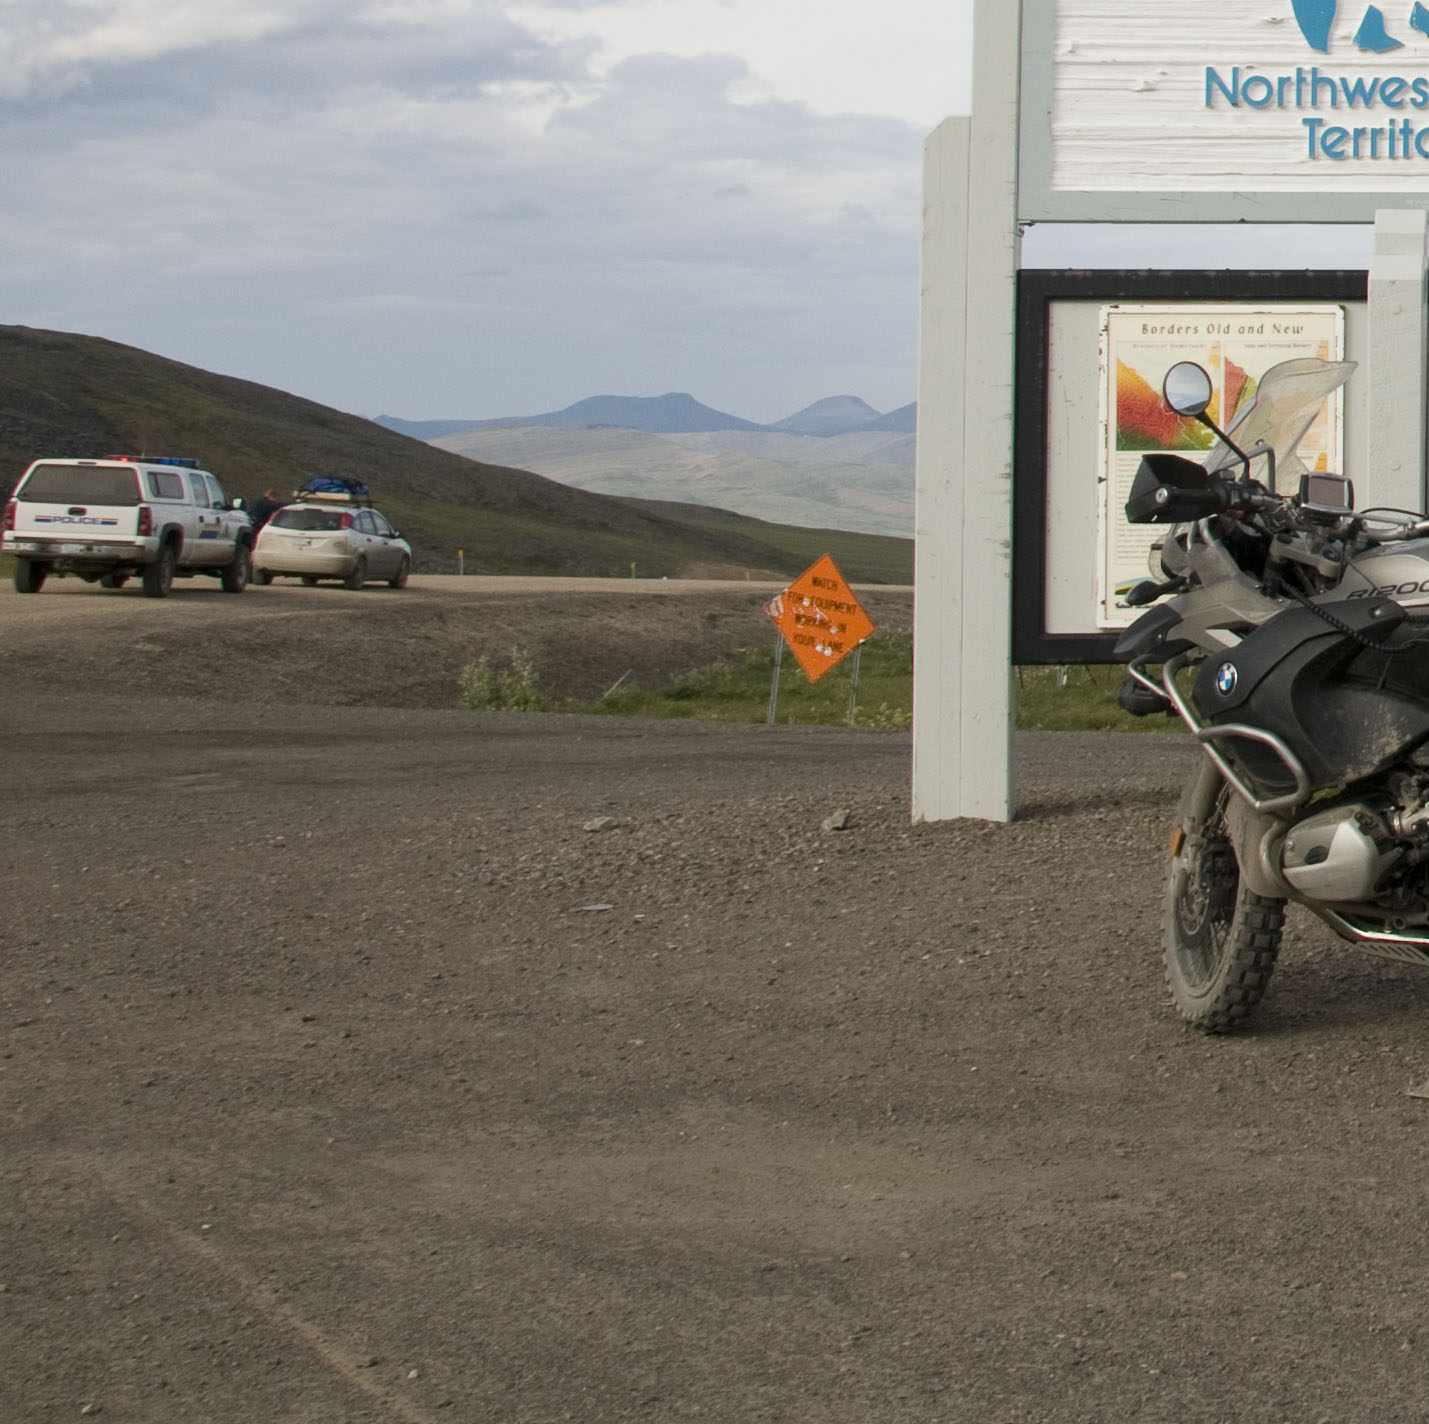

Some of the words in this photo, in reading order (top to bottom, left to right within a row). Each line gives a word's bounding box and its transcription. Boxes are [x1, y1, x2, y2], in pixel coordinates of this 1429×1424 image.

[1141, 323, 1200, 335] Borders
[1206, 323, 1231, 335] Old
[1237, 323, 1265, 335] and
[1271, 323, 1305, 335] New
[52, 515, 101, 526] POLICE
[813, 577, 838, 591] WATCH
[786, 591, 804, 604] FOR
[809, 596, 857, 615] EQUIPMENT
[793, 633, 815, 645] YOUR
